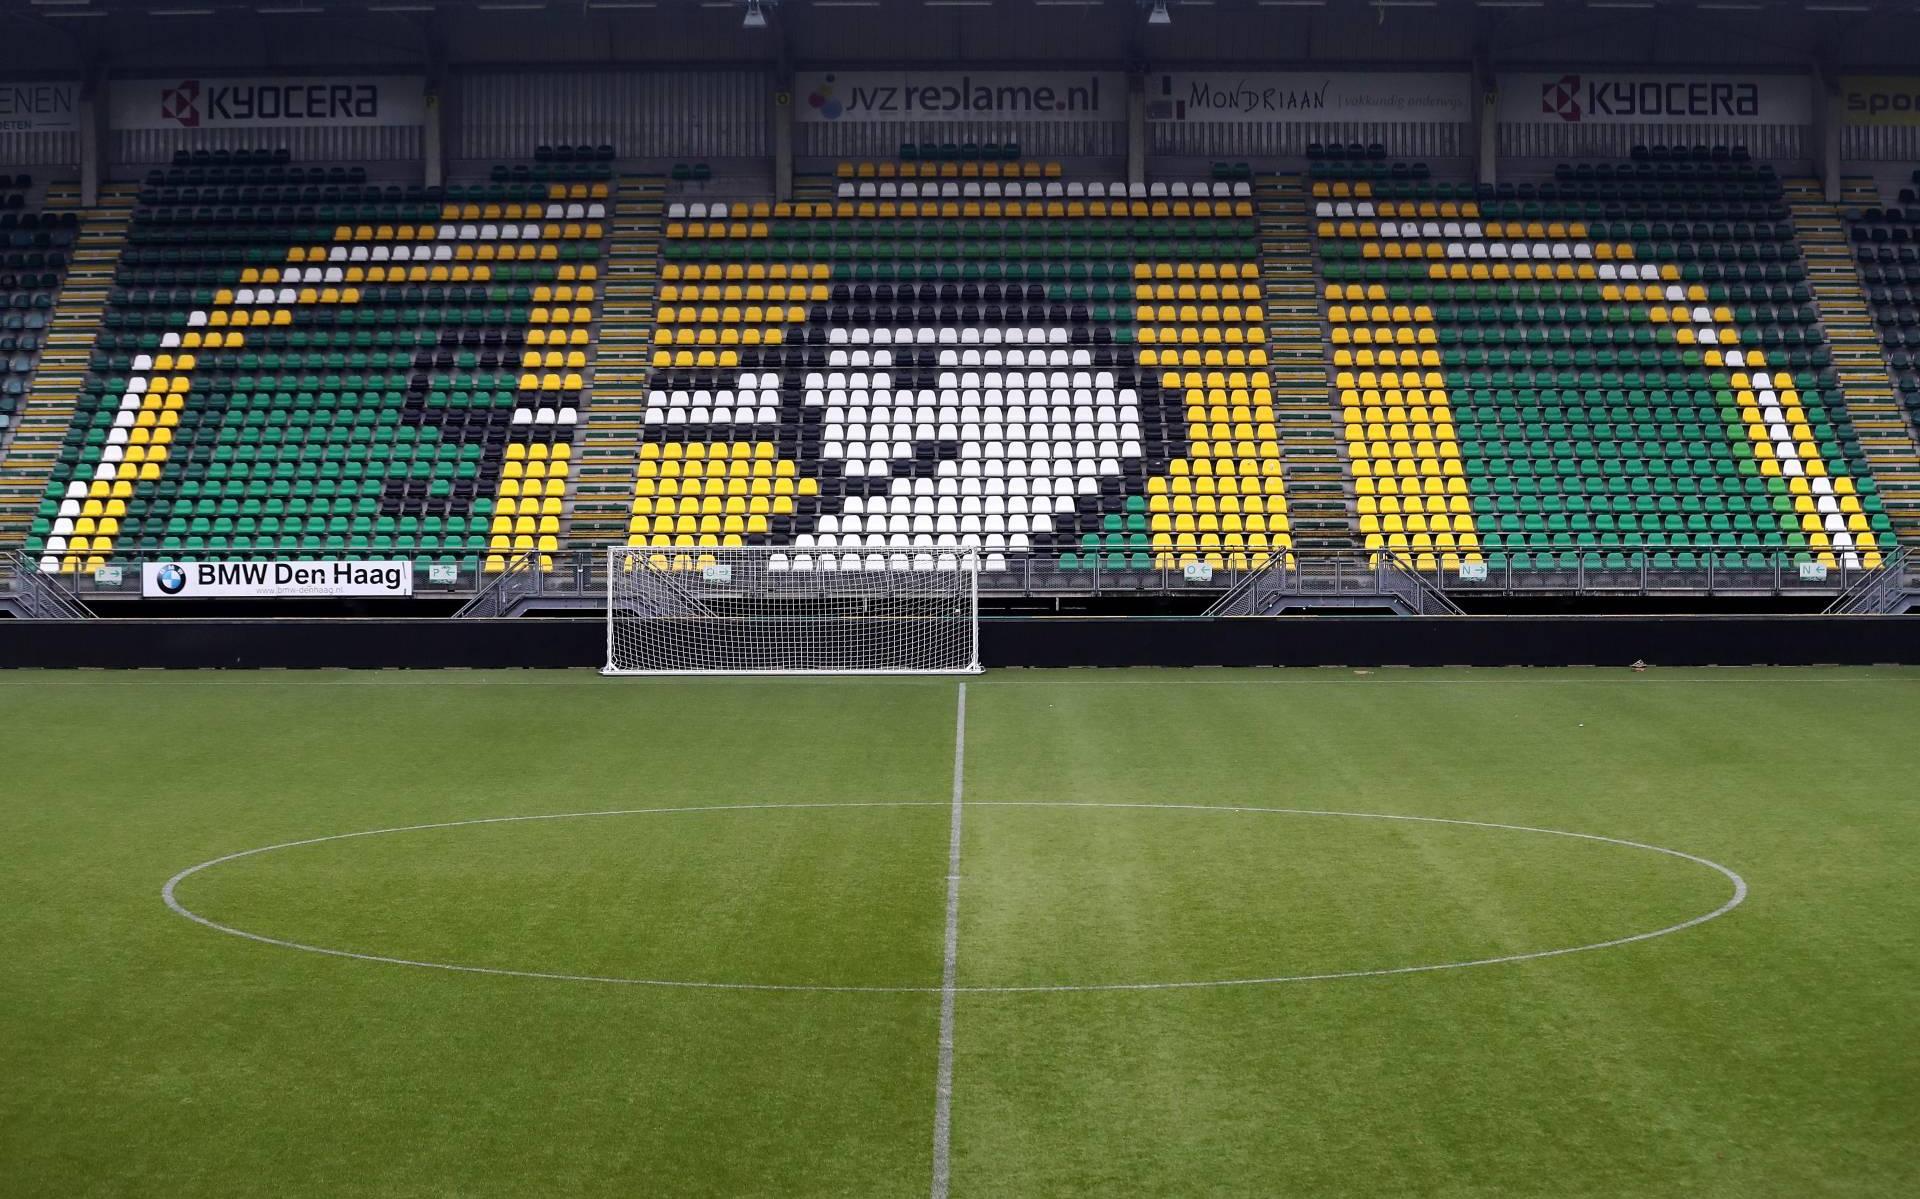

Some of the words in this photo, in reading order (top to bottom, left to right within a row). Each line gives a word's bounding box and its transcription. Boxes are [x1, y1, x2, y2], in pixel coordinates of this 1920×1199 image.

[208, 85, 377, 119] KYOCERA
[1188, 80, 1331, 112] MONDRIAAN
[1588, 82, 1759, 116] KYOCERA
[198, 563, 268, 585] BMW
[274, 563, 325, 585] Den
[333, 563, 401, 590] Haag
[1462, 565, 1471, 575] N
[1802, 565, 1811, 575] N
